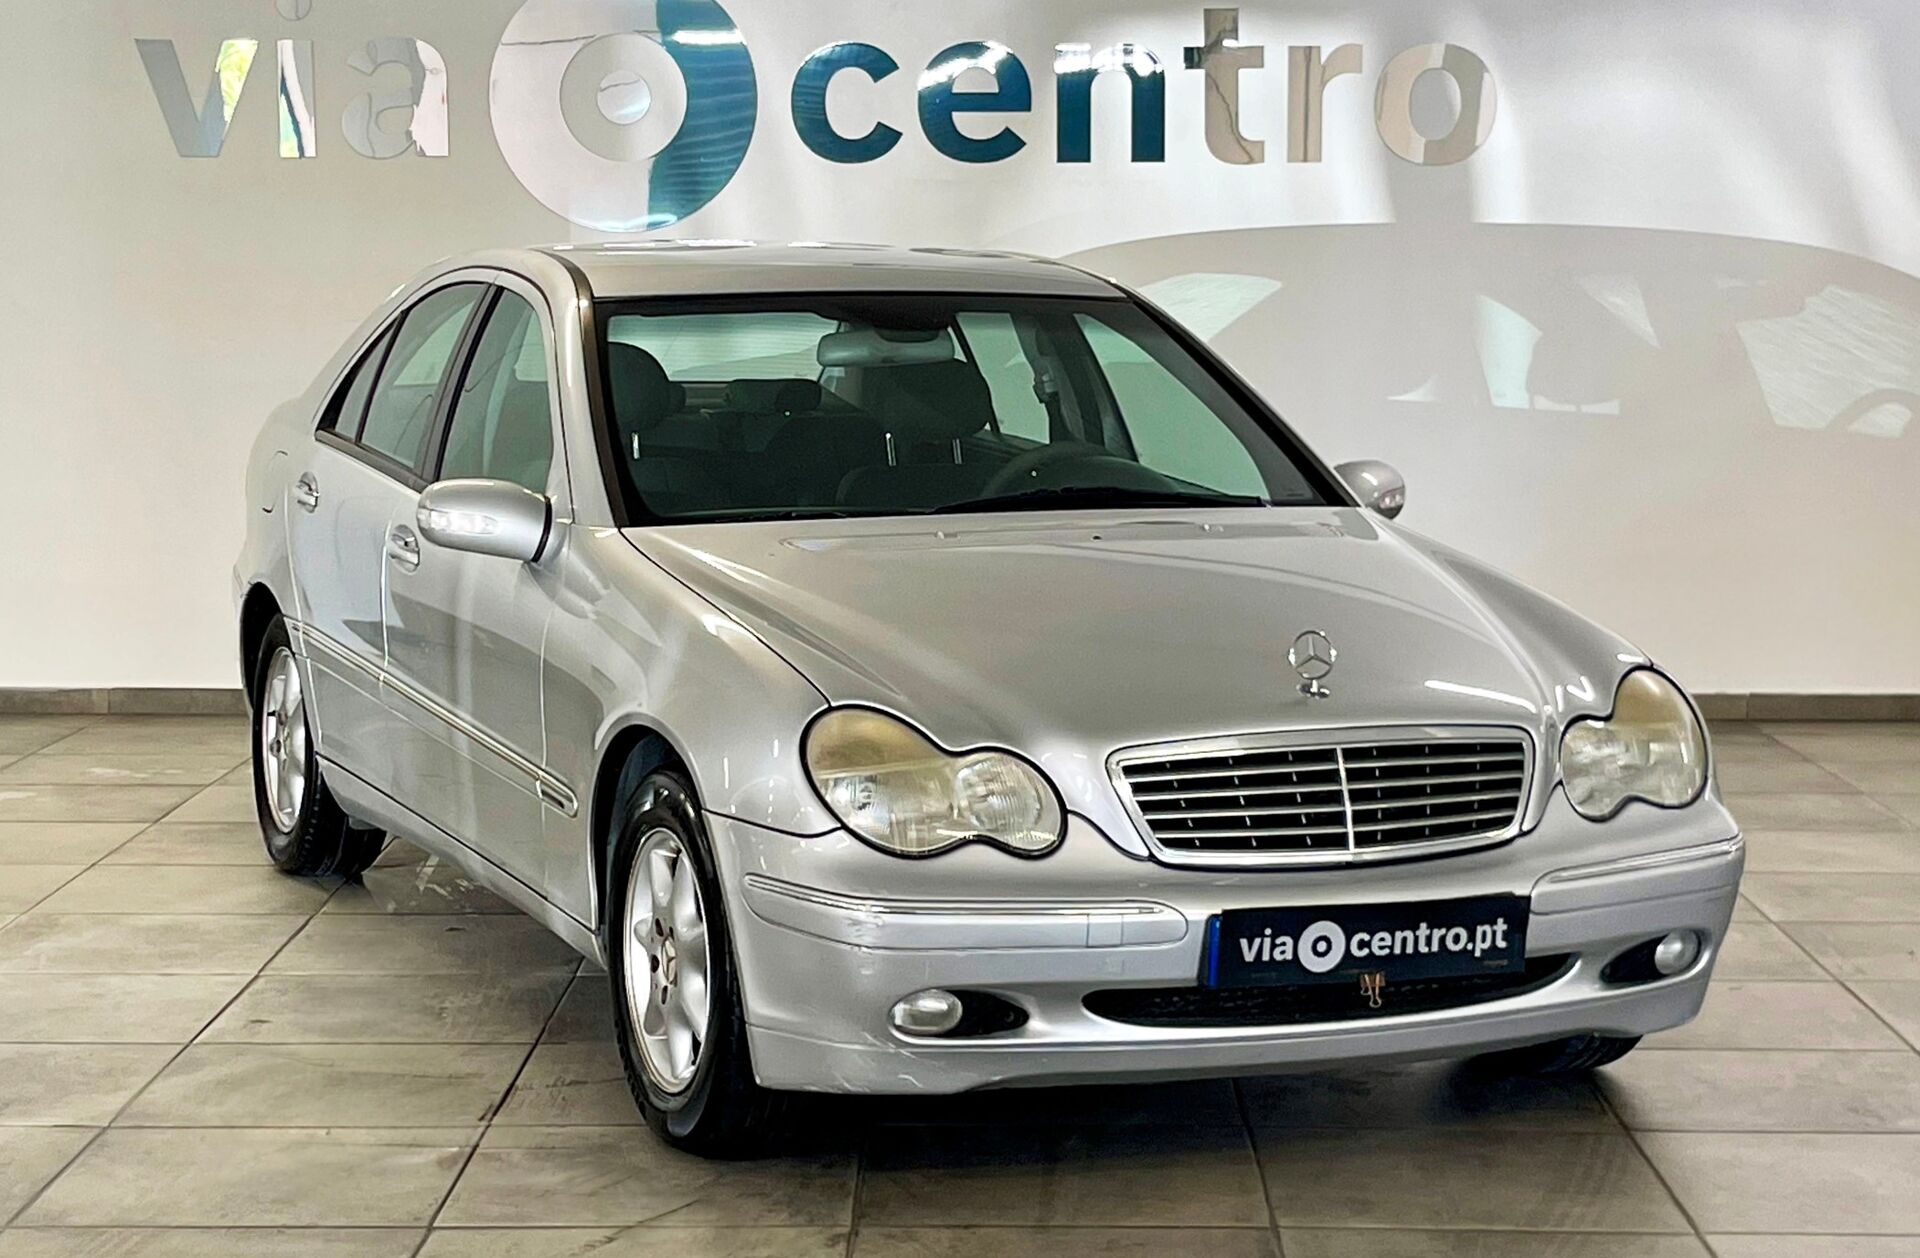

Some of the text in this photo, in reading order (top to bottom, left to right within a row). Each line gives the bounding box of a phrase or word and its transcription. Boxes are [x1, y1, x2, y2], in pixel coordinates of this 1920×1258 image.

[135, 0, 1499, 165] via centro
[1239, 917, 1508, 962] via centro.pt
